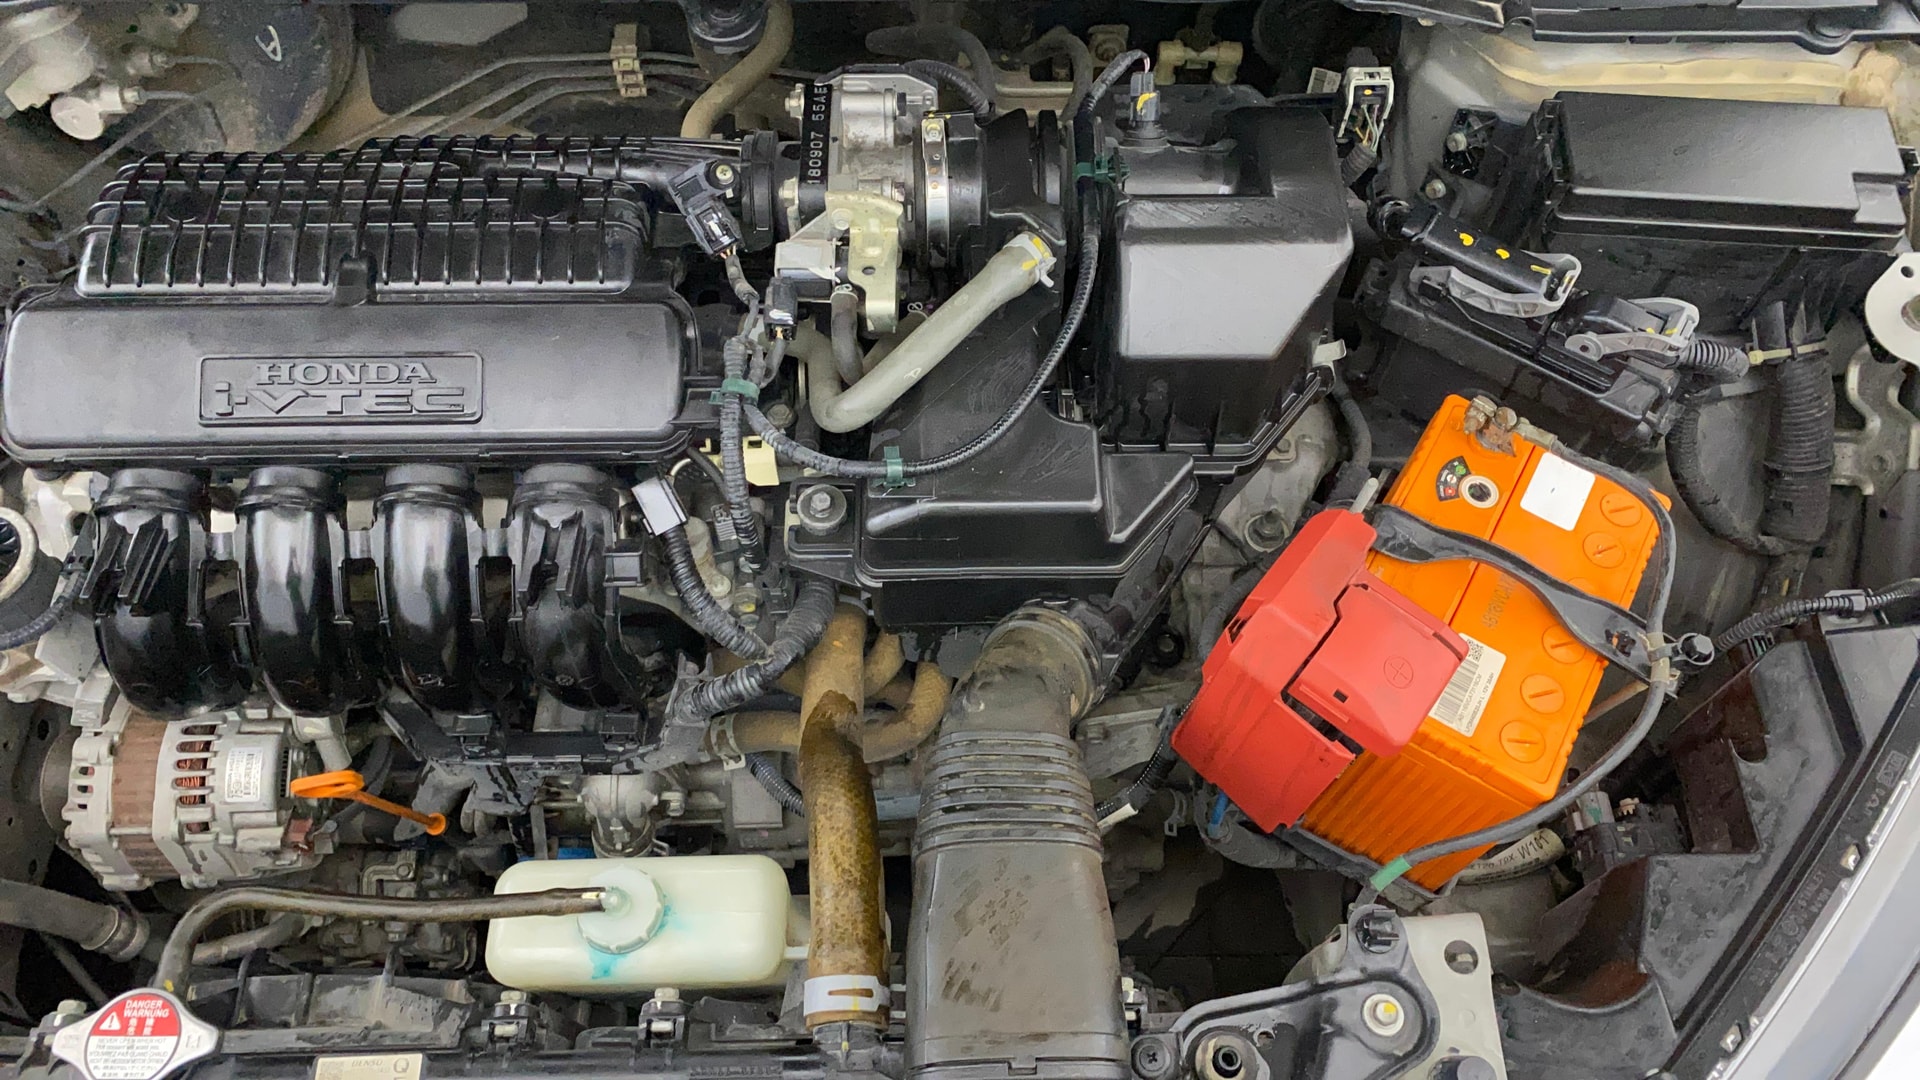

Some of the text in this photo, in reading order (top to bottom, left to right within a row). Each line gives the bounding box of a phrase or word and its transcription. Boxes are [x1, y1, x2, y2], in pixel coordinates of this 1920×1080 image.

[807, 131, 825, 185] 180907
[256, 362, 437, 385] HONDA
[215, 381, 465, 415] i-VTEC
[123, 1008, 169, 1018] WARNUNG
[126, 1000, 163, 1009] DANGER
[393, 1057, 410, 1074] Q
